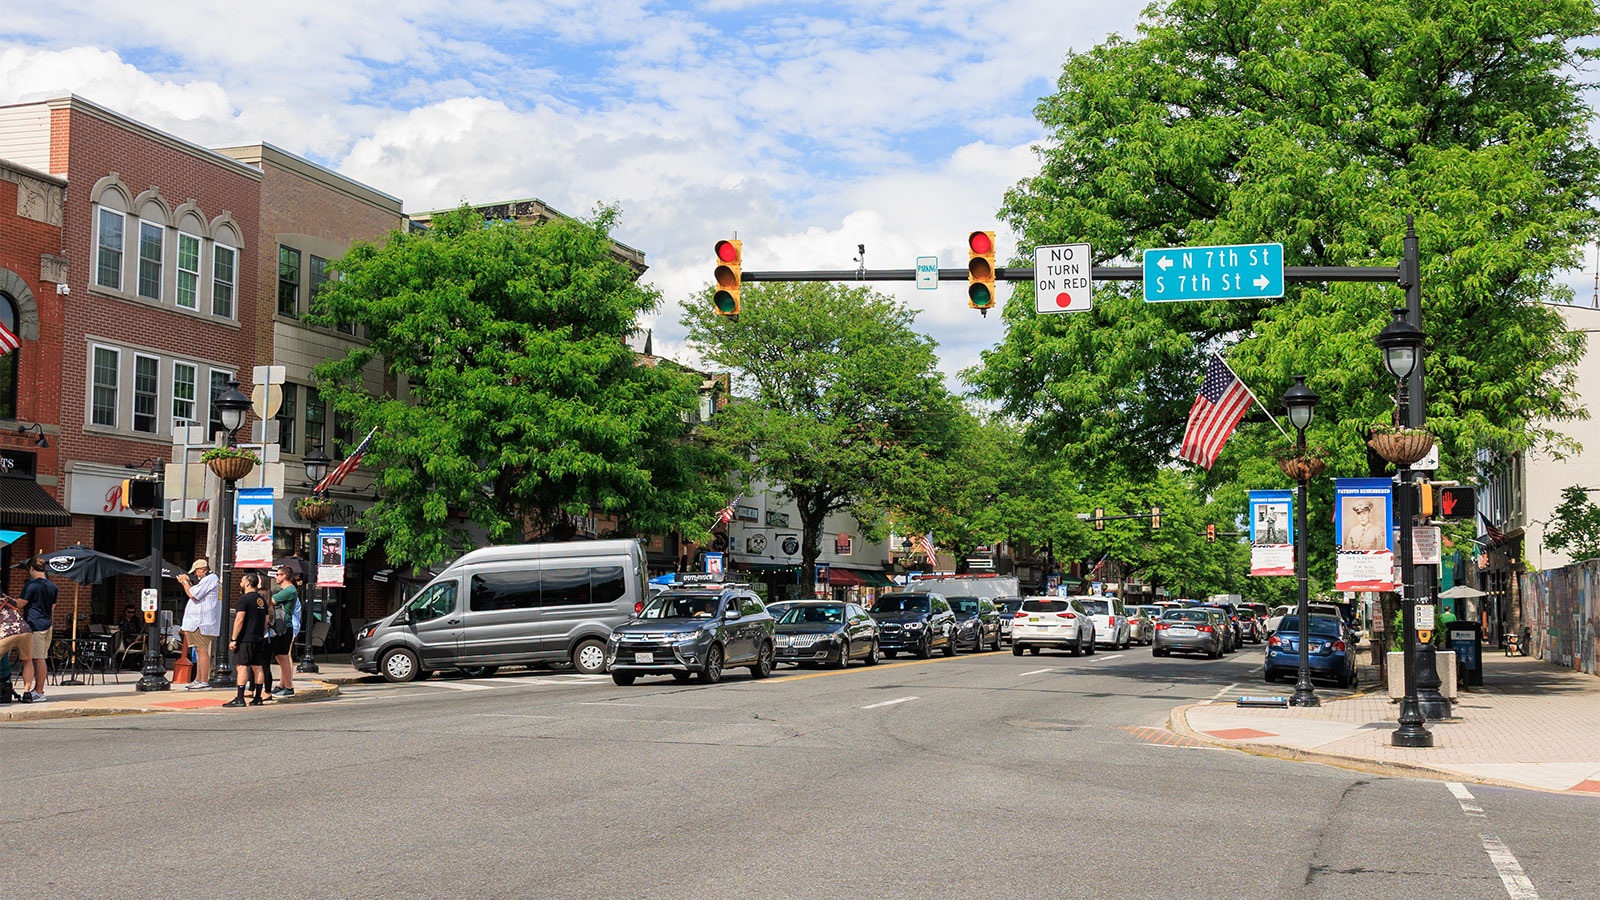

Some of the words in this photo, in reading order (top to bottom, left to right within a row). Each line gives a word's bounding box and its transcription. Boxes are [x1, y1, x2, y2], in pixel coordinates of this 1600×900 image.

[1051, 248, 1074, 262] NO
[1183, 252, 1193, 269] N
[1206, 249, 1238, 268] 7th
[1249, 248, 1269, 266] St
[1047, 264, 1079, 276] TURN
[1039, 280, 1056, 291] ON
[1063, 277, 1088, 289] RED
[1156, 276, 1165, 293] S
[1178, 273, 1211, 292] 7th
[1222, 273, 1241, 290] St
